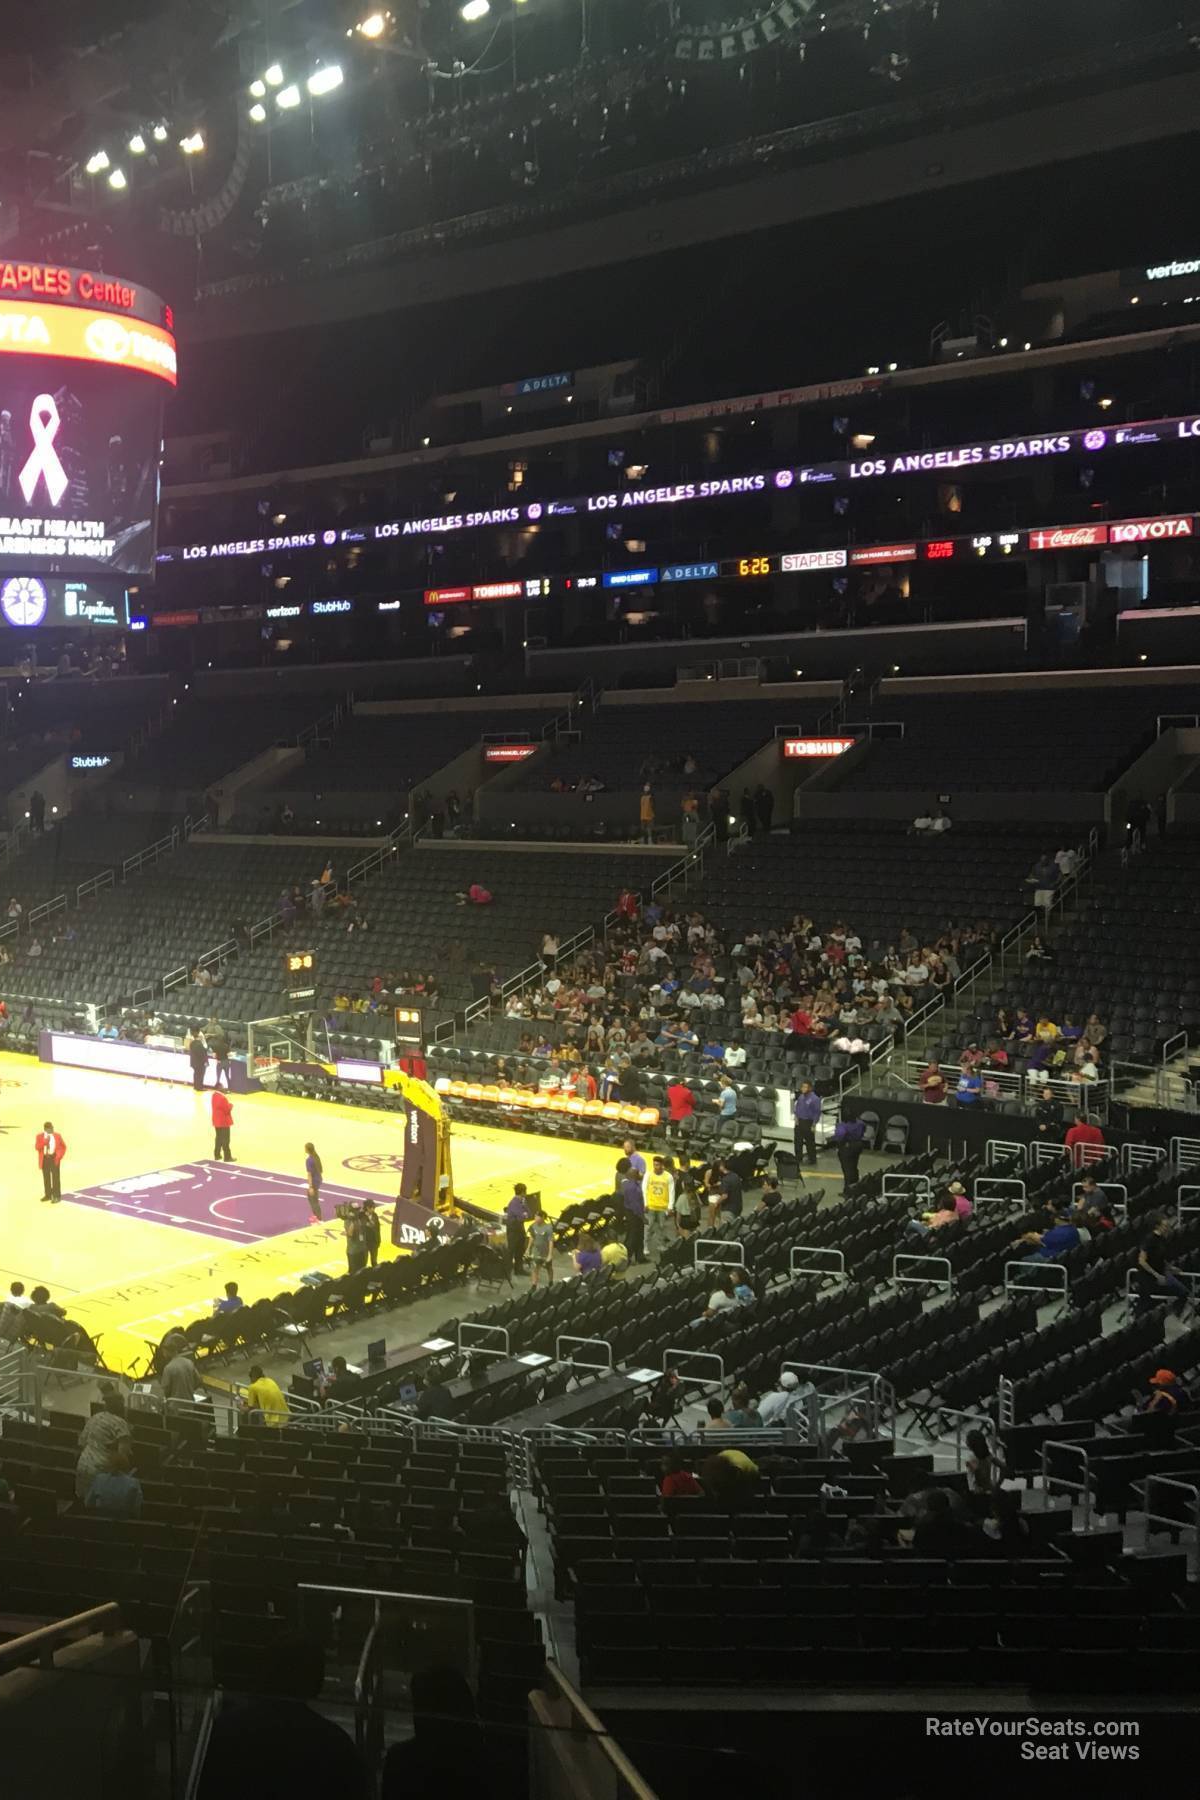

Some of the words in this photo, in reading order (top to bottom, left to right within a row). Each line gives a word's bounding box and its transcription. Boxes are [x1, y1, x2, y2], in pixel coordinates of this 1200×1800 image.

[78, 273, 135, 307] Center
[533, 375, 568, 390] DELTA
[850, 459, 886, 478] LOS
[891, 448, 982, 474] ANGELES
[989, 437, 1070, 461] SPARKS
[588, 495, 617, 511] LOS
[621, 484, 695, 507] ANGELES
[700, 475, 765, 496] SPARKS
[44, 519, 104, 538] HEALTH
[375, 524, 399, 538] LOS
[402, 515, 463, 535] ANGELES
[466, 508, 519, 526] SPARKS
[1111, 520, 1191, 542] TOYOTA
[183, 546, 207, 559] LOS
[210, 539, 264, 557] ANGELES
[268, 533, 316, 550] SPARKS
[928, 542, 953, 551] TIME
[928, 549, 953, 559] OUTS
[739, 557, 770, 576] 6:26
[784, 552, 845, 570] STAPLES
[675, 566, 717, 579] DELTA
[473, 584, 521, 598] TOSHIBA
[267, 606, 300, 618] verizon
[313, 600, 351, 613] StubHub
[410, 1110, 418, 1144] verizon
